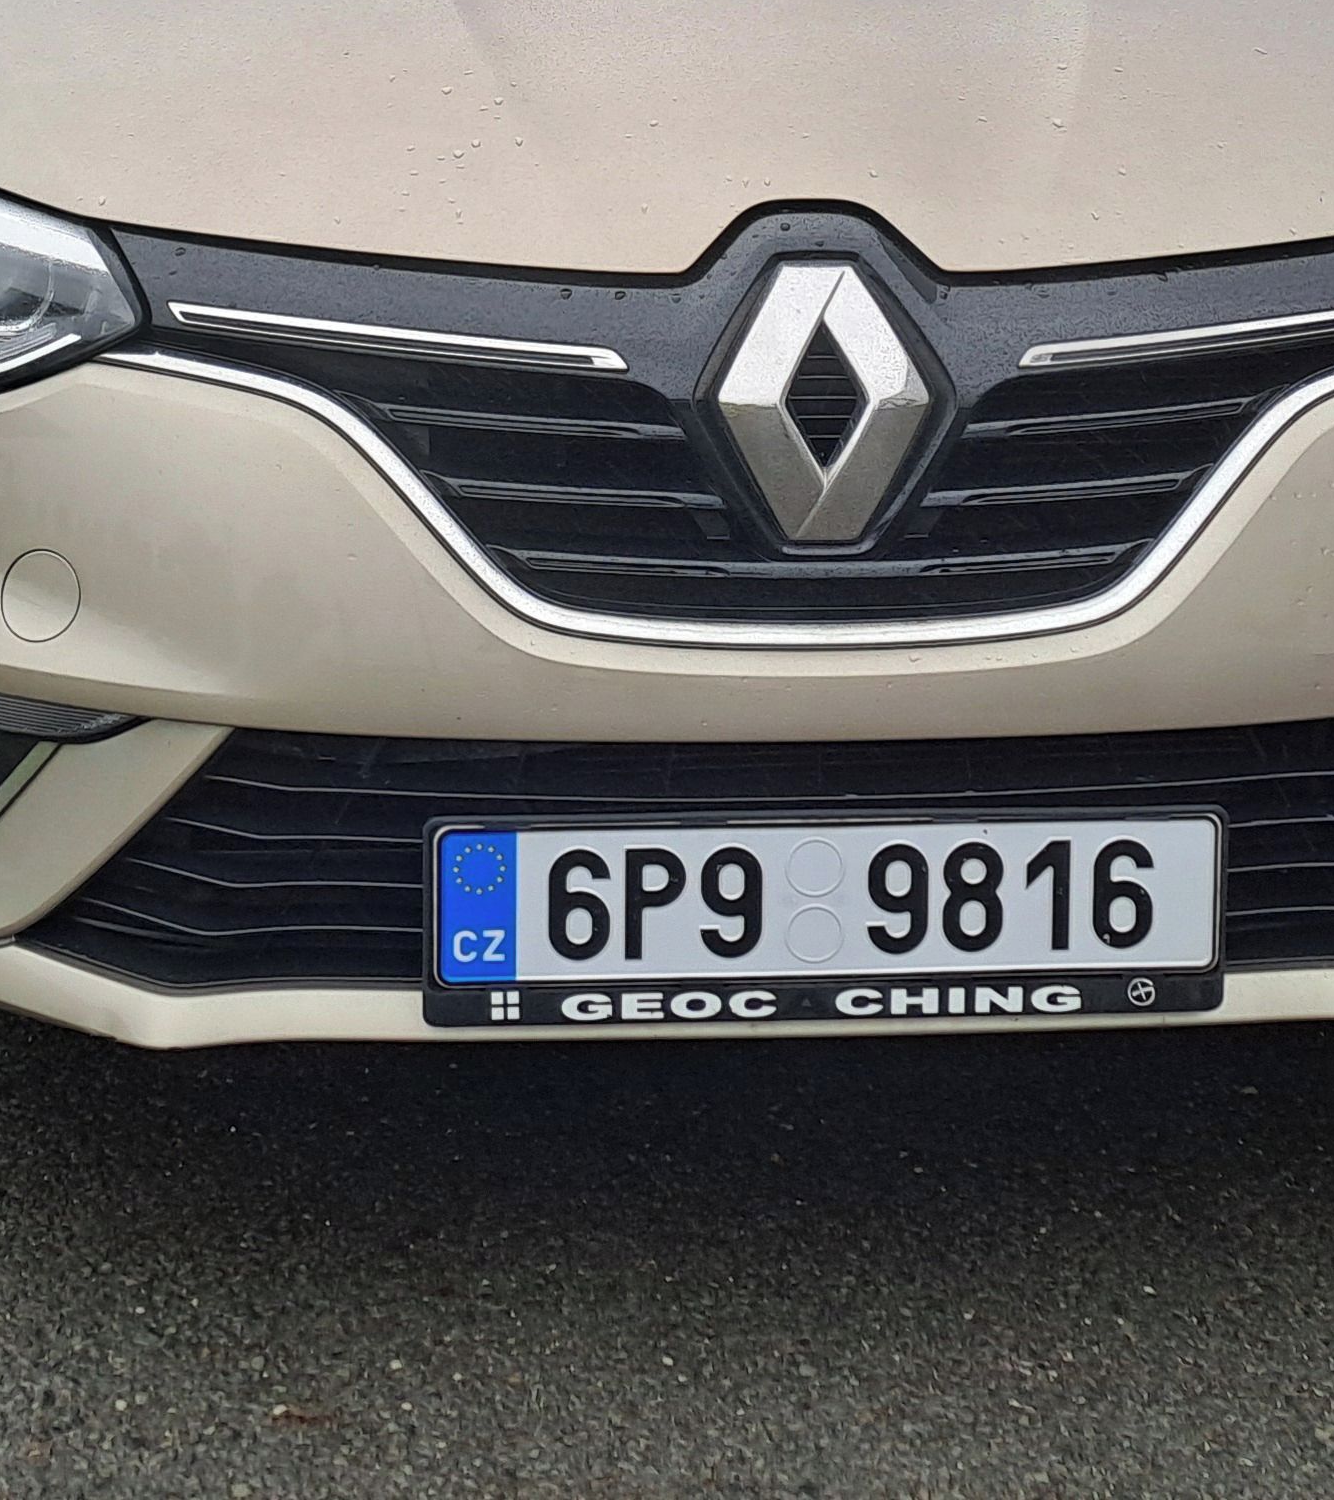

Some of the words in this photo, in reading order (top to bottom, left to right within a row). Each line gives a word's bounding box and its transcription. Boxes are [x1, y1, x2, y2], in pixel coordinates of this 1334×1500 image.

[547, 845, 764, 960] 6P9
[866, 839, 1156, 955] 9816
[452, 929, 506, 964] CZ
[561, 989, 778, 1021] GEOC
[834, 984, 1083, 1016] CHING
